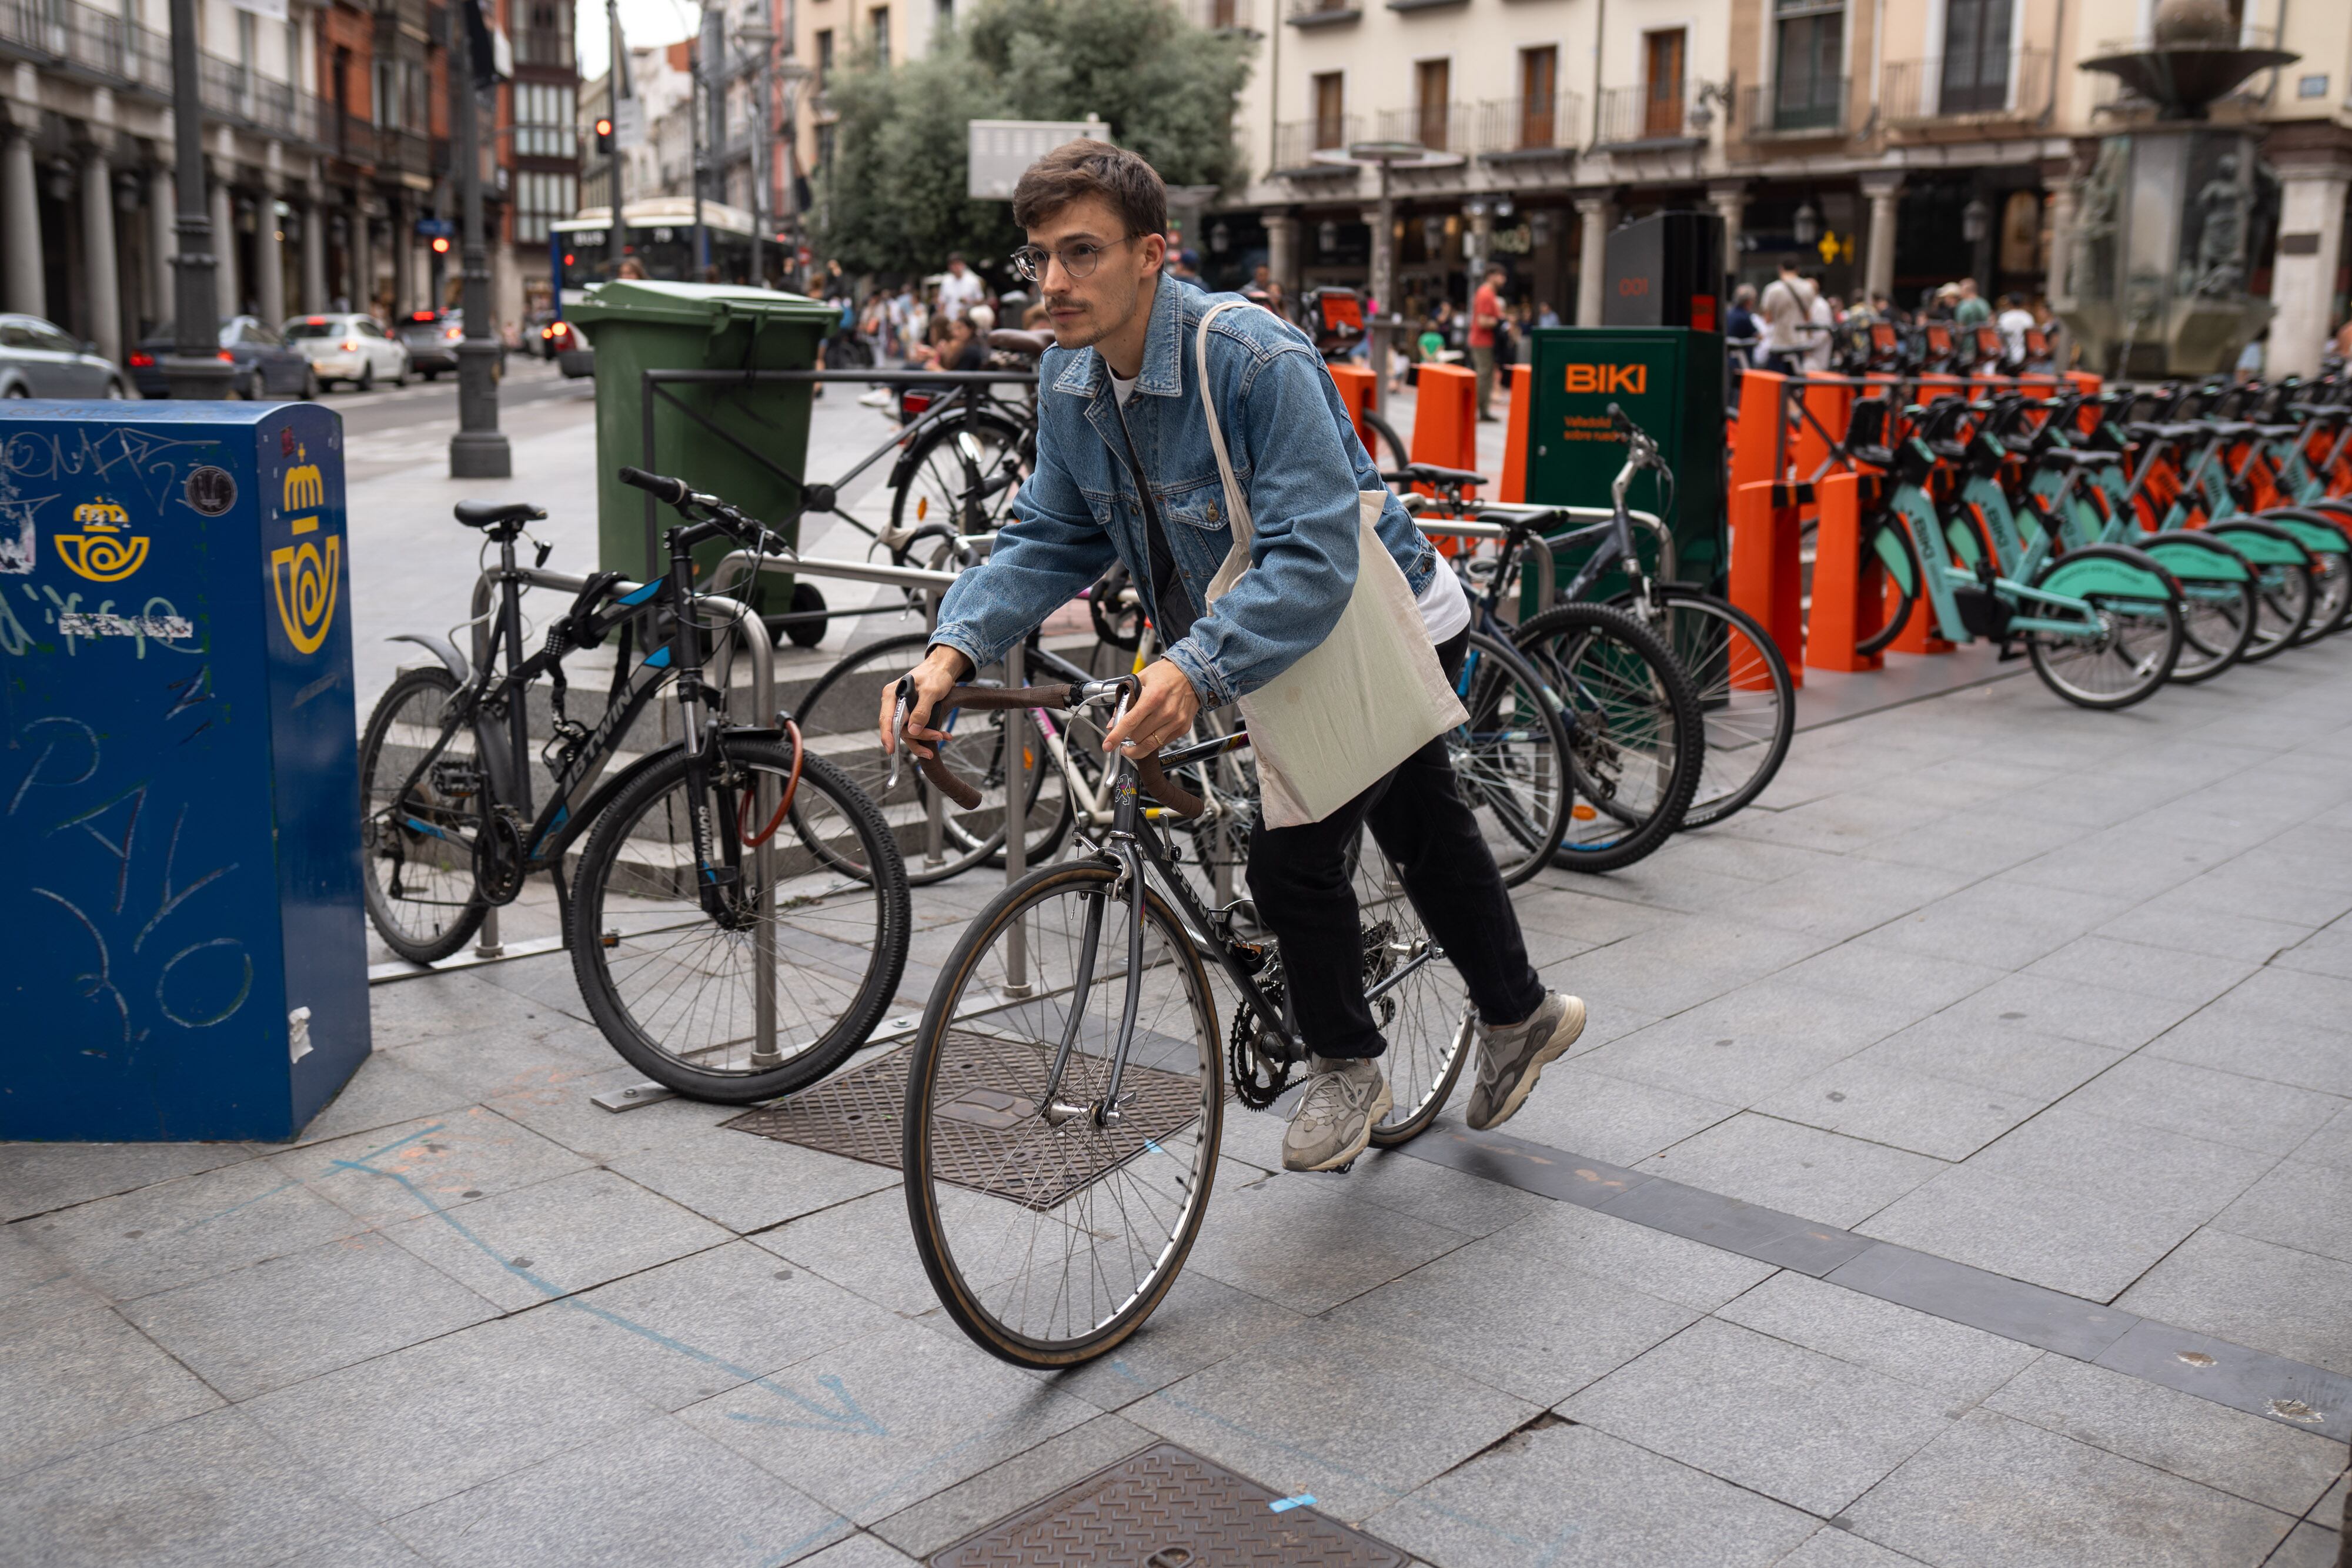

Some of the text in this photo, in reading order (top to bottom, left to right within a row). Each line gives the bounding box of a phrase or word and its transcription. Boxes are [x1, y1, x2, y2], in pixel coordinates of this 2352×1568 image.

[573, 230, 606, 246] BUS
[1619, 277, 1649, 297] 001
[1565, 363, 1646, 394] BIKI
[1161, 757, 1172, 765] Made
[1175, 753, 1188, 761] France
